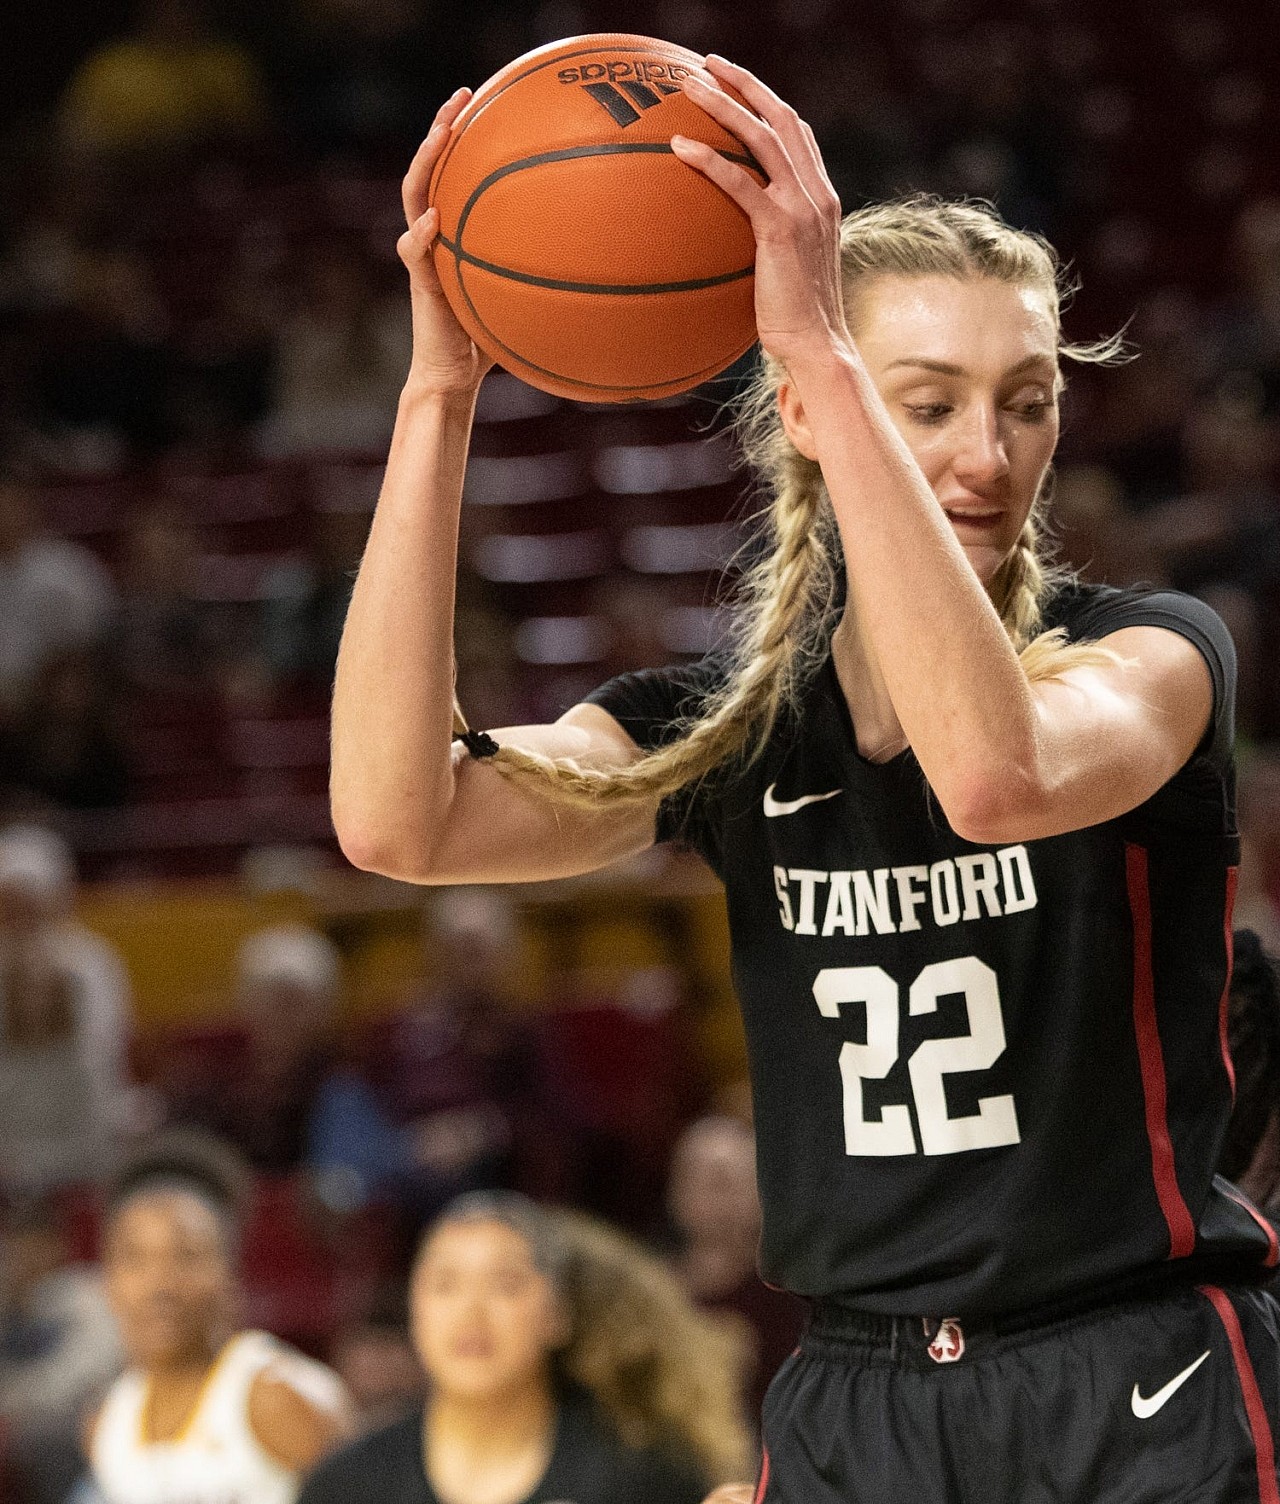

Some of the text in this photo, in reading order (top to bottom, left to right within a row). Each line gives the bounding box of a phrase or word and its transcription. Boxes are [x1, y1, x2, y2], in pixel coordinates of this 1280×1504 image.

[557, 60, 690, 85] adidas
[773, 844, 1038, 937] STANFORD
[812, 955, 1021, 1157] 22
